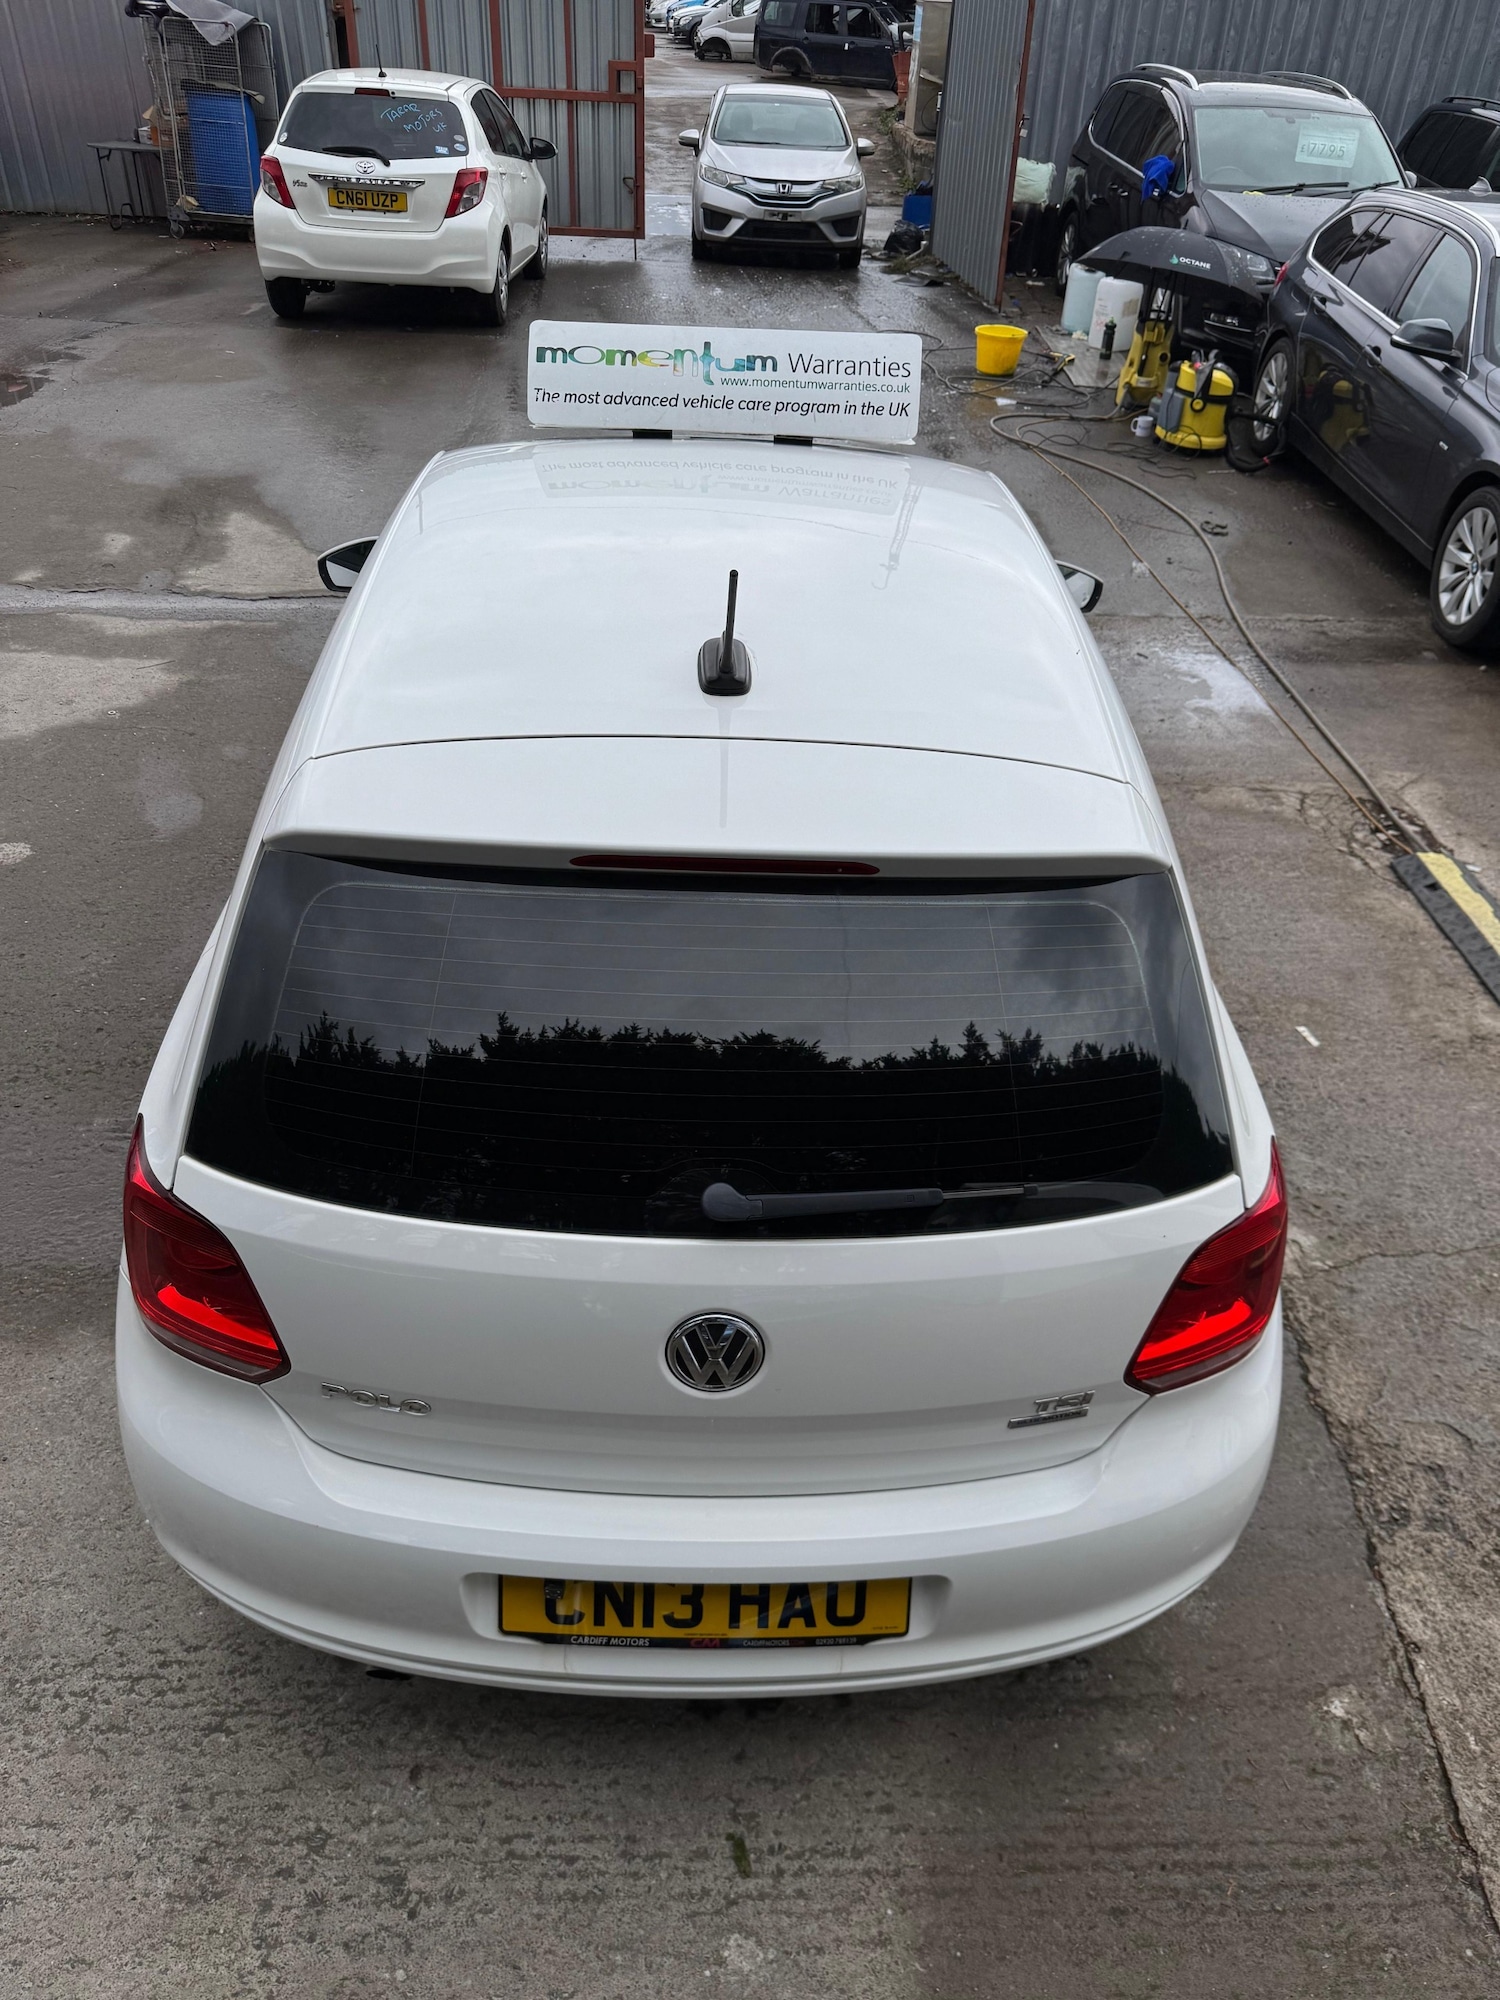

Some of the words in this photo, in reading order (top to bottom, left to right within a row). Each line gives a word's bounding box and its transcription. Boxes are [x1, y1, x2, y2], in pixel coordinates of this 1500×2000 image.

[403, 108, 443, 132] MOTORS
[1300, 142, 1346, 158] £7795
[336, 190, 367, 206] CN61
[371, 193, 399, 208] UZP
[1179, 256, 1211, 269] OCTANE
[536, 341, 778, 386] momentum
[788, 353, 911, 378] Warranties
[720, 377, 911, 393] www.momentumwarranties.co.uk
[534, 388, 560, 403] The
[564, 391, 601, 405] most
[603, 391, 680, 408] advanced
[682, 394, 735, 410] vehicle
[738, 400, 771, 412] care
[774, 400, 842, 416] program
[844, 400, 857, 415] in
[861, 401, 885, 416] the
[888, 402, 911, 417] UK
[321, 1381, 431, 1416] POLO
[1033, 1389, 1095, 1414] TSI
[571, 1635, 609, 1645] CARDIFF
[609, 1637, 650, 1646] MOTORS
